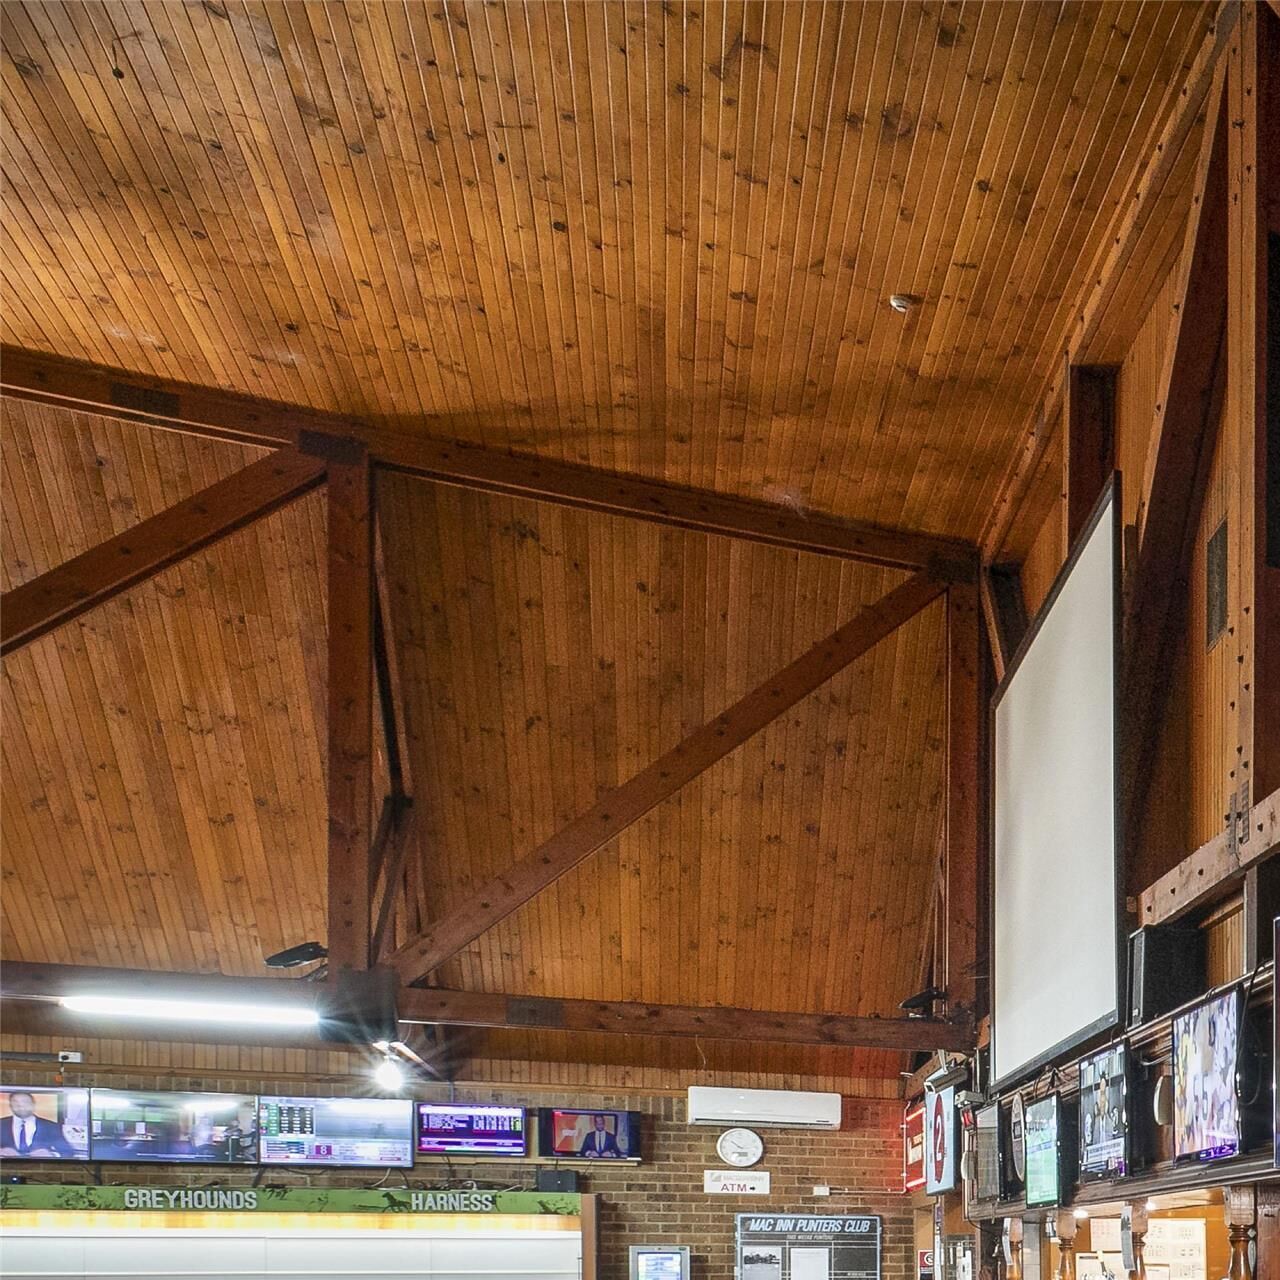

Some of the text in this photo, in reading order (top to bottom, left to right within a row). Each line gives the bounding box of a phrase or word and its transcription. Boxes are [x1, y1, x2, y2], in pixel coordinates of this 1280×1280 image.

[319, 1145, 328, 1155] 8
[720, 1183, 747, 1192] ATM
[124, 1189, 257, 1209] GREYHOUNDS
[411, 1193, 493, 1211] HARNESS
[749, 1219, 871, 1232] MAC INN PUNTERS CLUB
